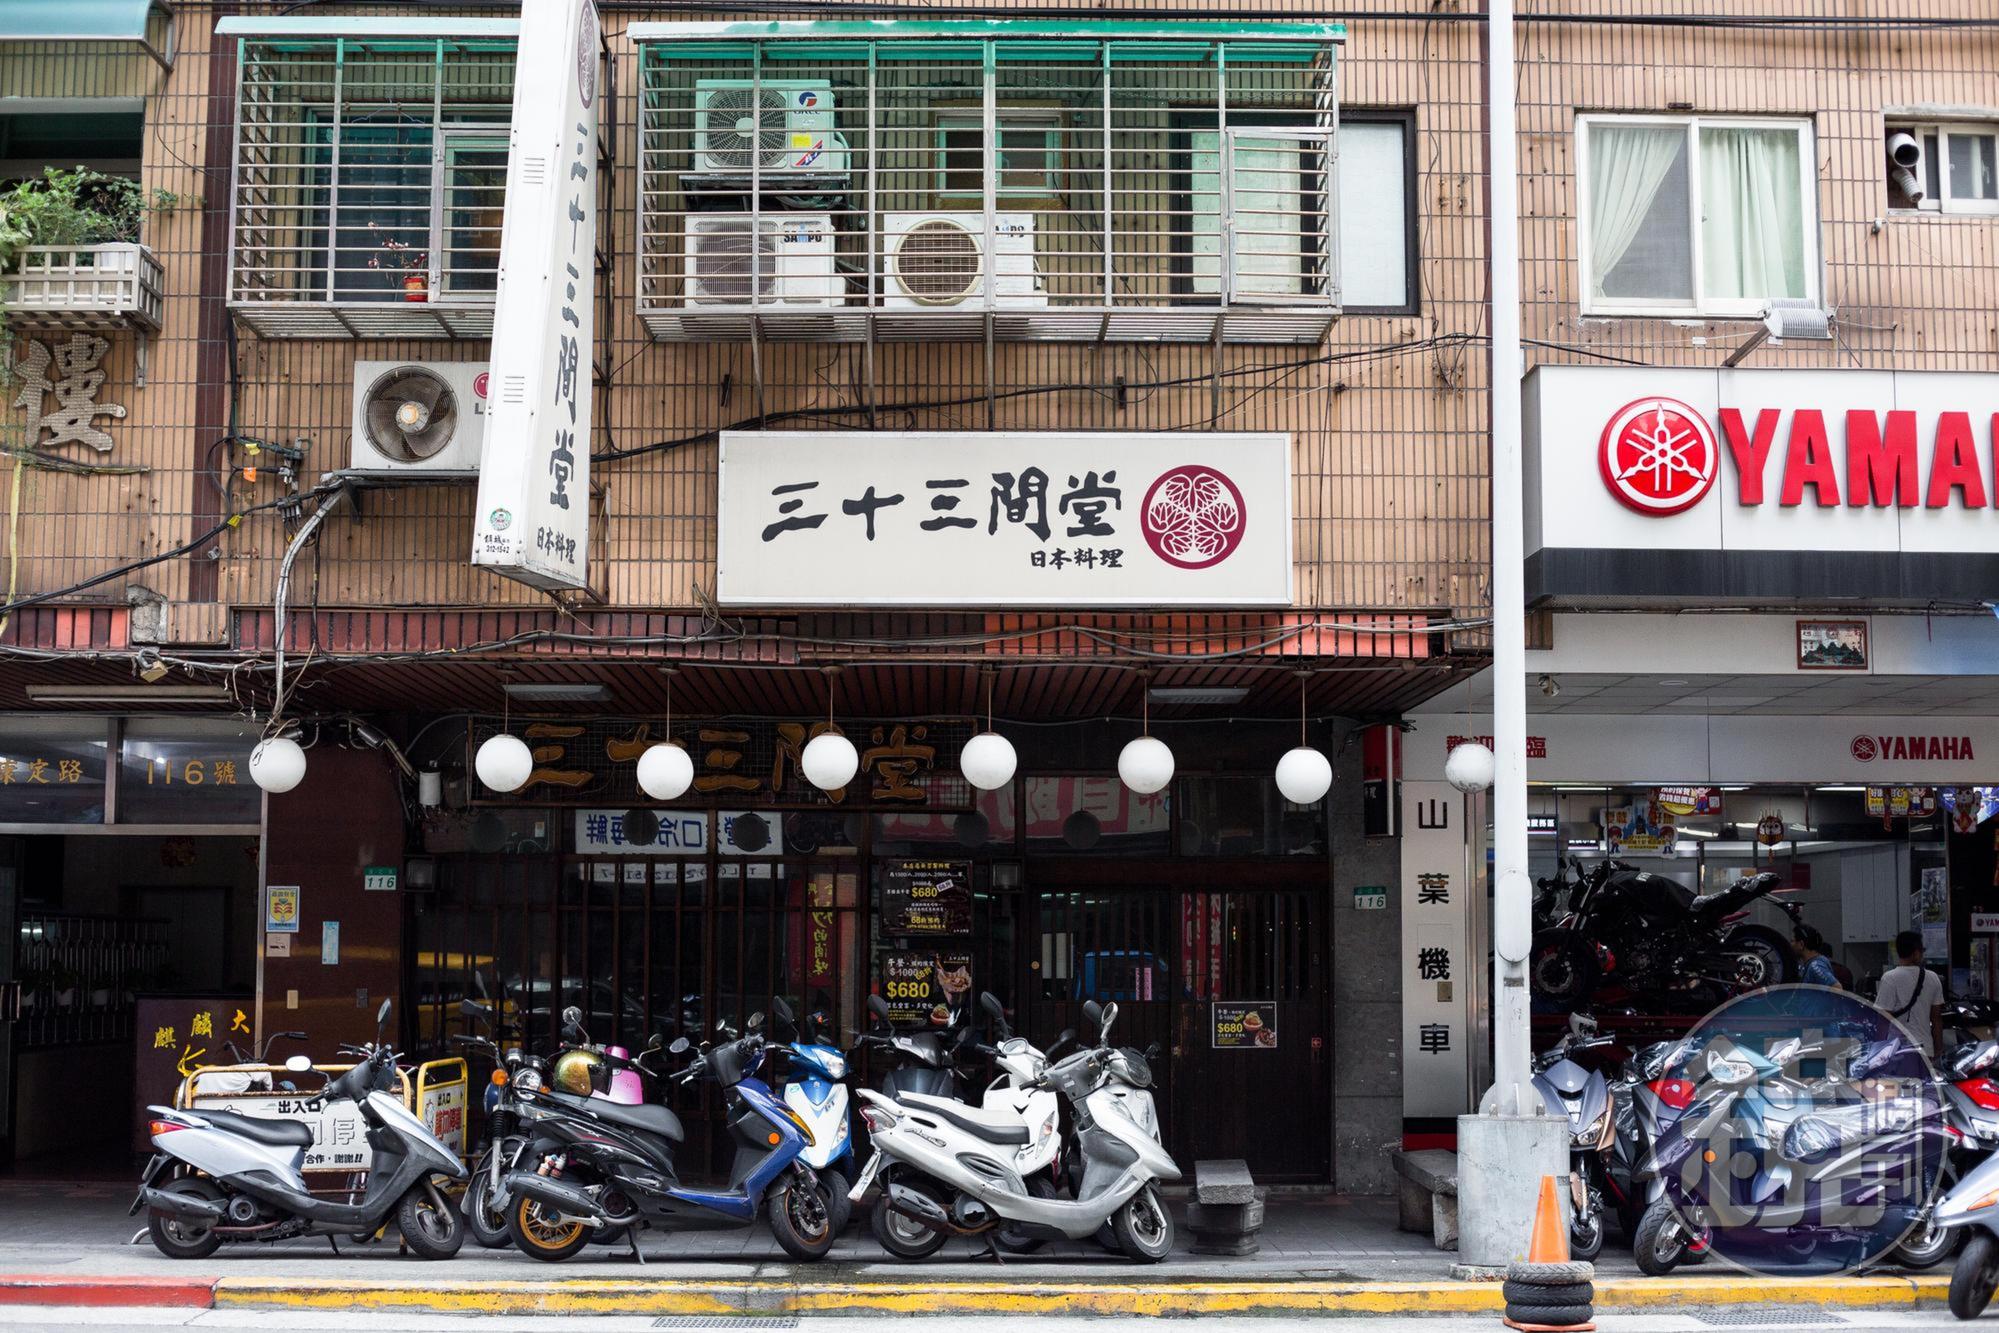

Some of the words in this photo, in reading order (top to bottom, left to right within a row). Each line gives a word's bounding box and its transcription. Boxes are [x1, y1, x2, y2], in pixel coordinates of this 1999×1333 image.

[550, 122, 588, 511] 三十三間堂
[1718, 407, 1999, 509] YAMA
[762, 466, 1121, 543] 三十三間堂
[537, 526, 576, 564] 日本料理
[1031, 548, 1124, 570] 日本料理
[1879, 736, 1974, 760] YAMAHA
[367, 877, 395, 888] 116
[911, 887, 938, 898] $680
[1358, 896, 1384, 908] 116
[1418, 799, 1451, 1055] 山葉機車
[886, 980, 930, 999] $680
[1217, 1022, 1243, 1033] $680
[278, 1100, 322, 1114] 出入口
